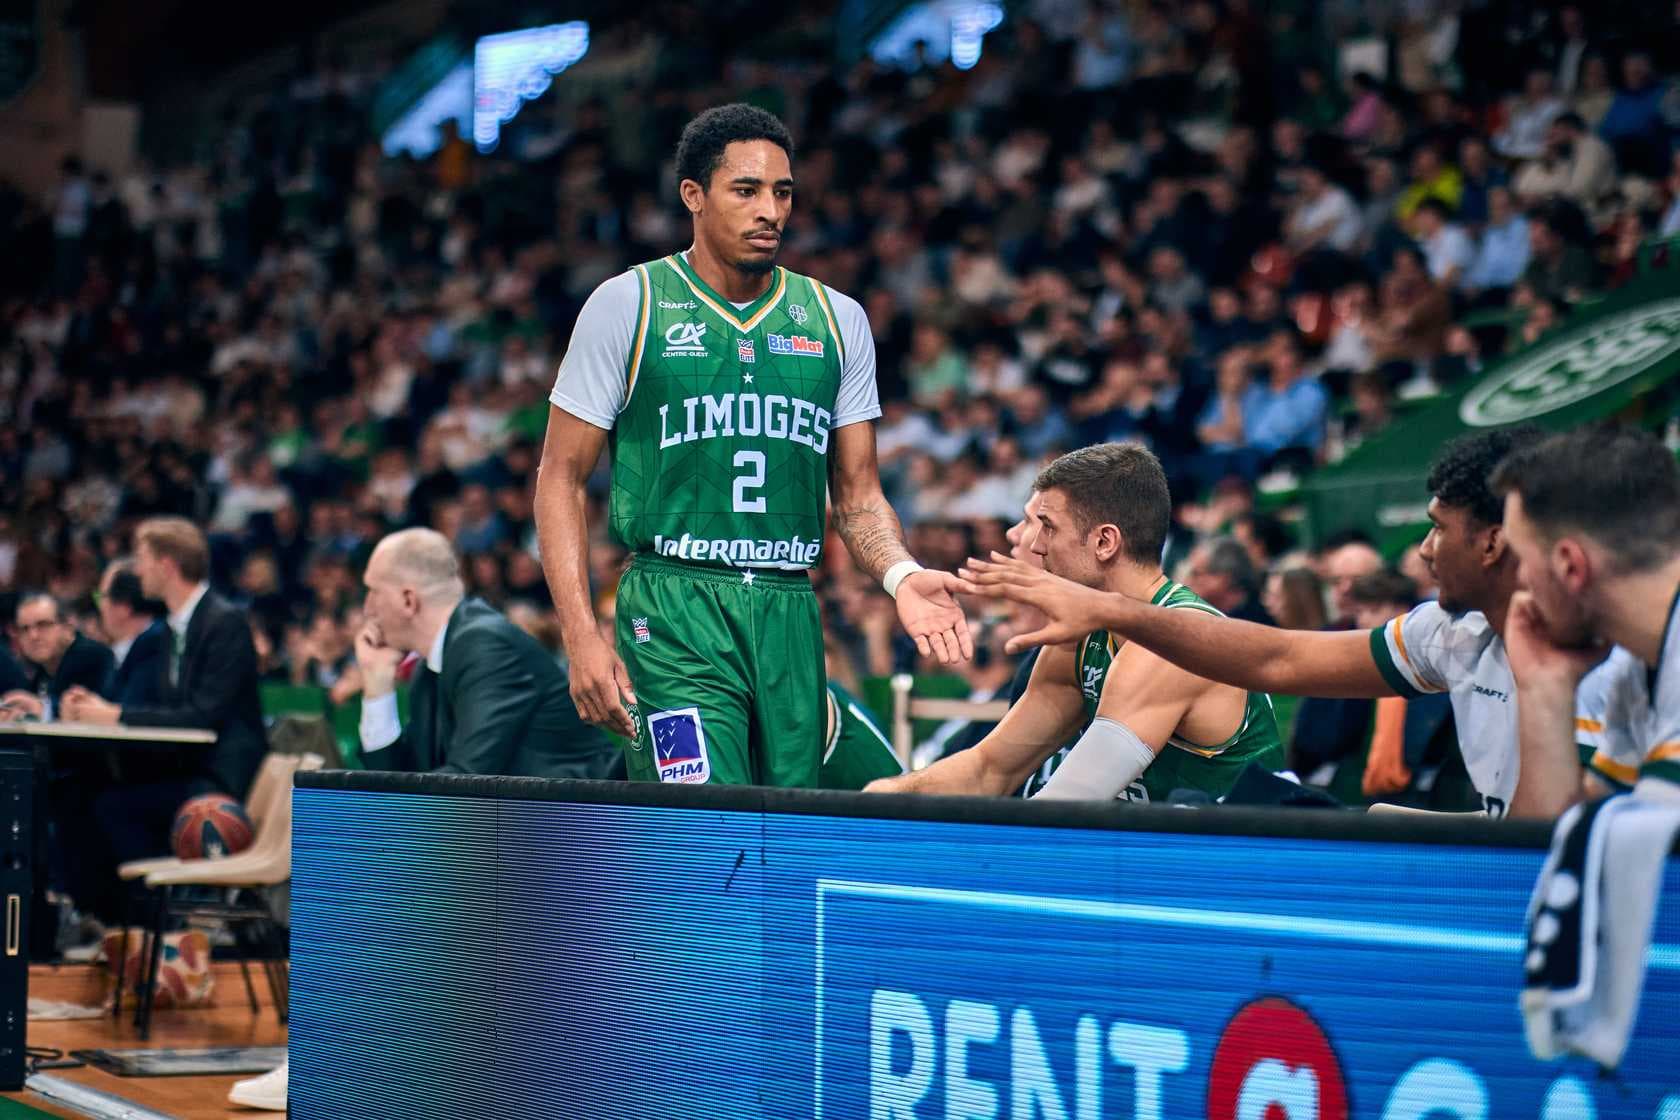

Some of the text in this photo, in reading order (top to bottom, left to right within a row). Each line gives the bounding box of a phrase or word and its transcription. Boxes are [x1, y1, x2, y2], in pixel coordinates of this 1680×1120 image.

[658, 301, 690, 309] CRAFT
[768, 334, 823, 354] BigMat
[659, 393, 831, 455] LIMOGES
[732, 450, 767, 513] 2
[654, 532, 820, 567] Intermarhé
[661, 761, 704, 782] PHM
